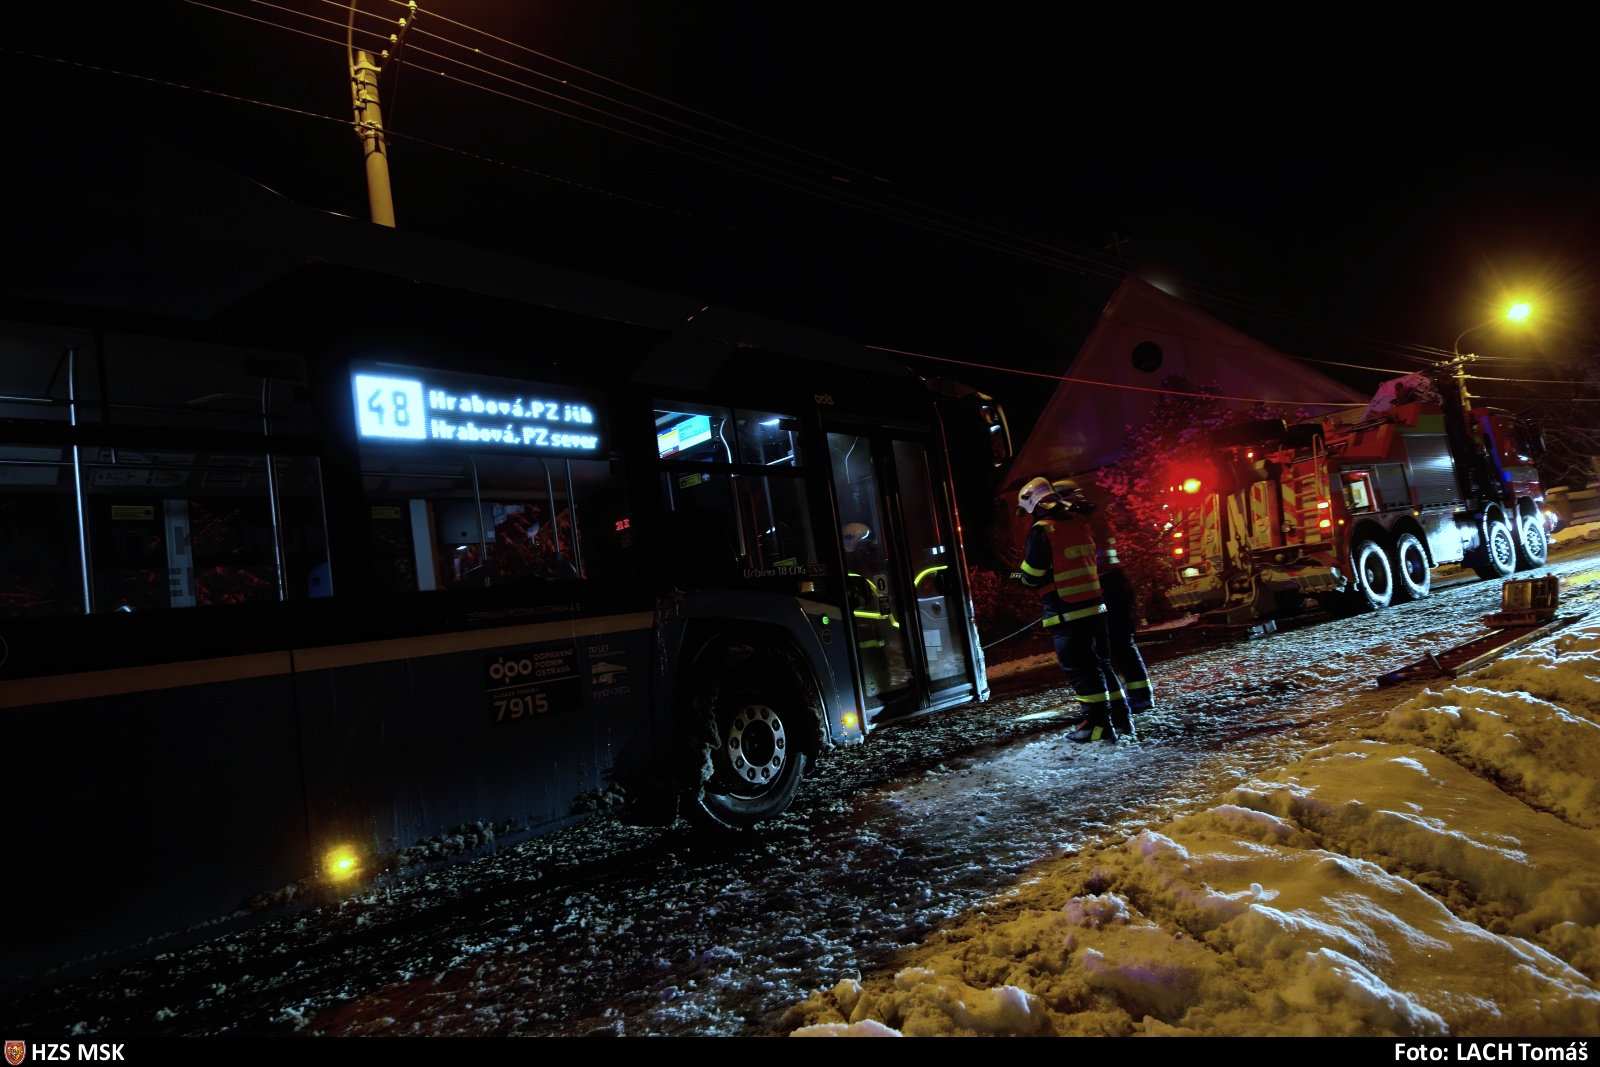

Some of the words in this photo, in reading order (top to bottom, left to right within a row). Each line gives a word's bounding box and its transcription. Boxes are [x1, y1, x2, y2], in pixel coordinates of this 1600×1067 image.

[367, 388, 411, 428] 48
[564, 405, 593, 424] jih
[550, 432, 598, 450] sever
[743, 567, 776, 579] Urbino
[533, 648, 573, 662] DOPRAVNÍ
[535, 658, 564, 670] PODNIK
[535, 664, 571, 677] OSTRAVA
[493, 693, 549, 722] 7915
